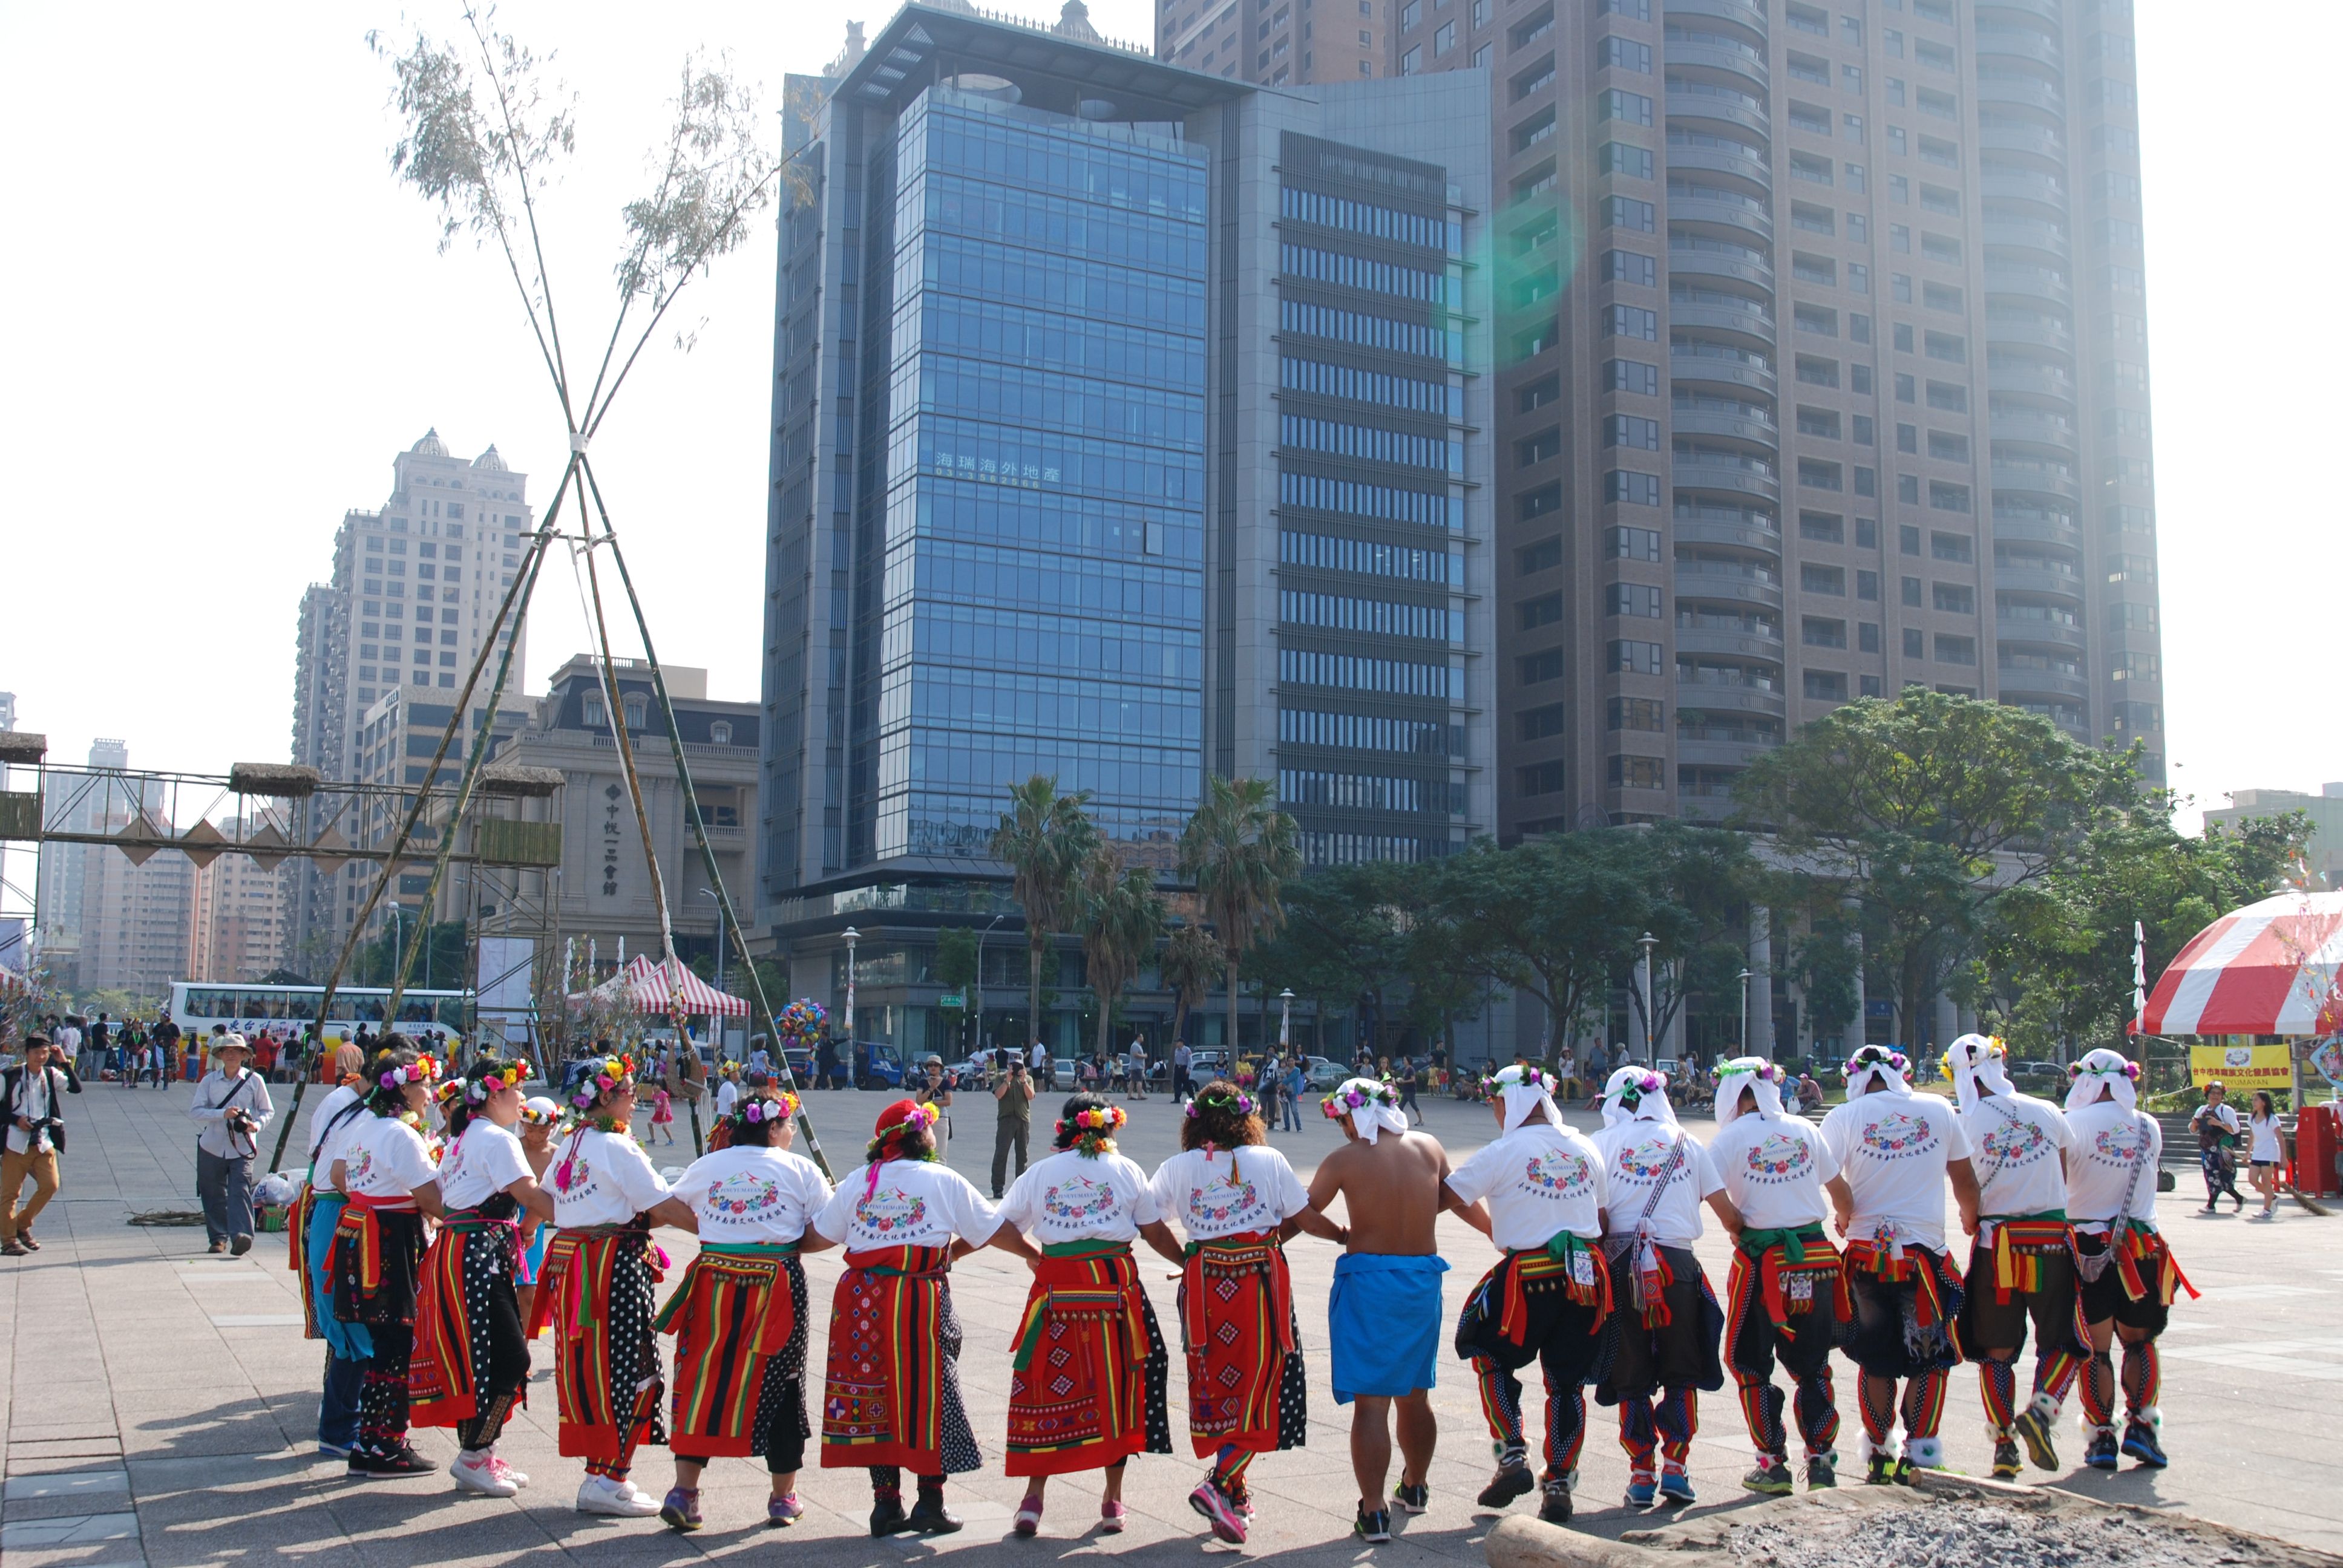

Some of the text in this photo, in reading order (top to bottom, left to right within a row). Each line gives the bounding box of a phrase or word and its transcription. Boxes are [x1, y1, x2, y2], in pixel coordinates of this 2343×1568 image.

[936, 452, 1060, 483] 海瑞海外地產
[2192, 1067, 2289, 1077] 台中市卑南族文化發展協會
